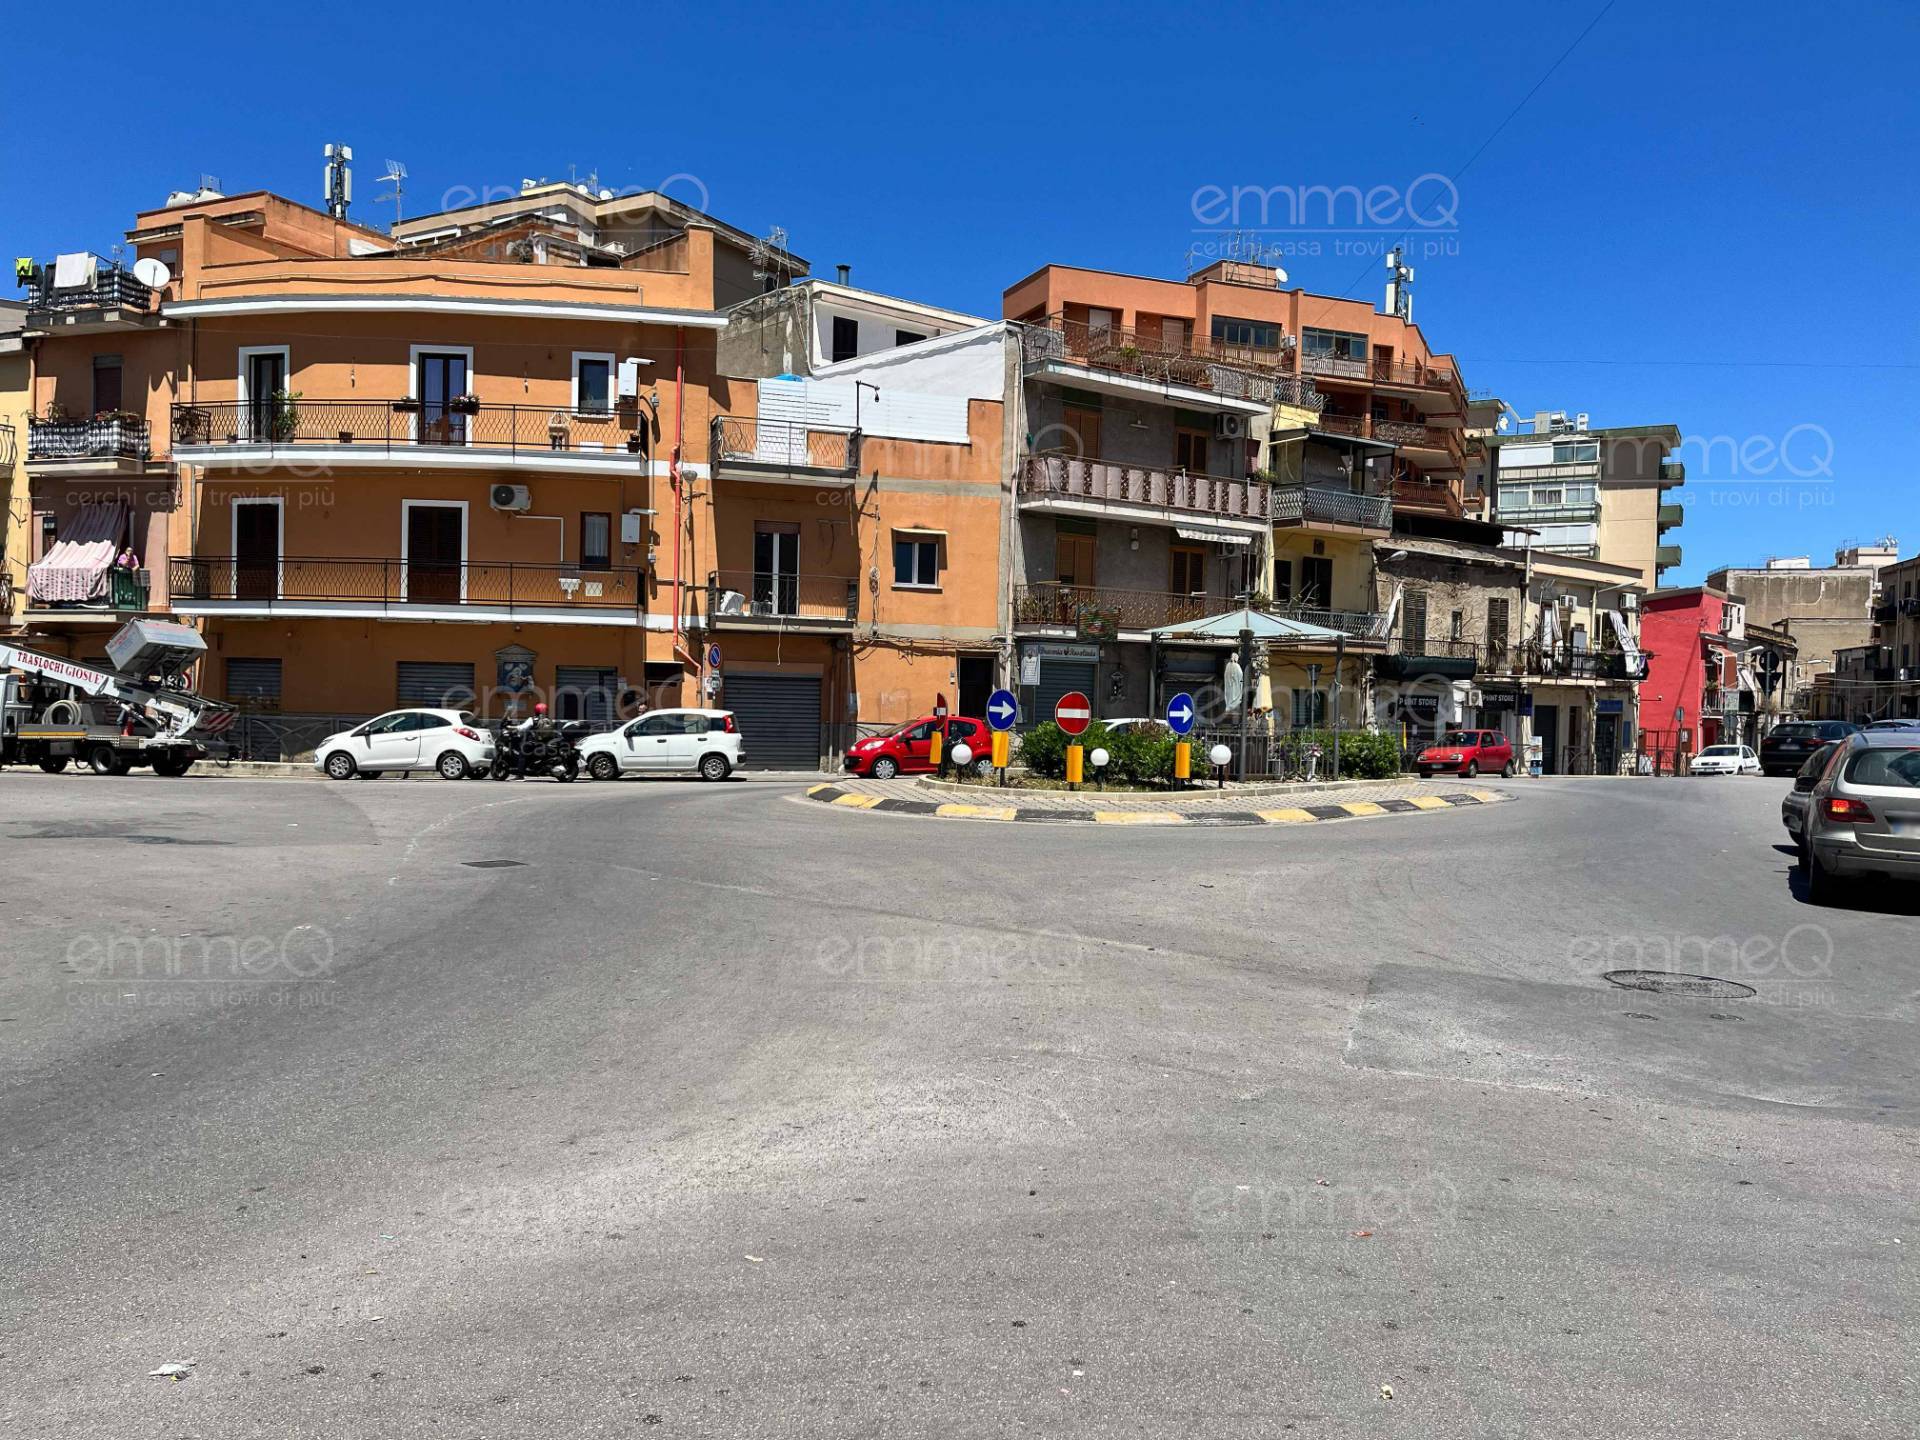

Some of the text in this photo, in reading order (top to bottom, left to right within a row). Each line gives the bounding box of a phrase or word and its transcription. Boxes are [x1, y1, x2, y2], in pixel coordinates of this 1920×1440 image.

[17, 651, 64, 674] TRASLOCHI
[1418, 698, 1438, 707] STORE
[1498, 694, 1515, 702] STORE
